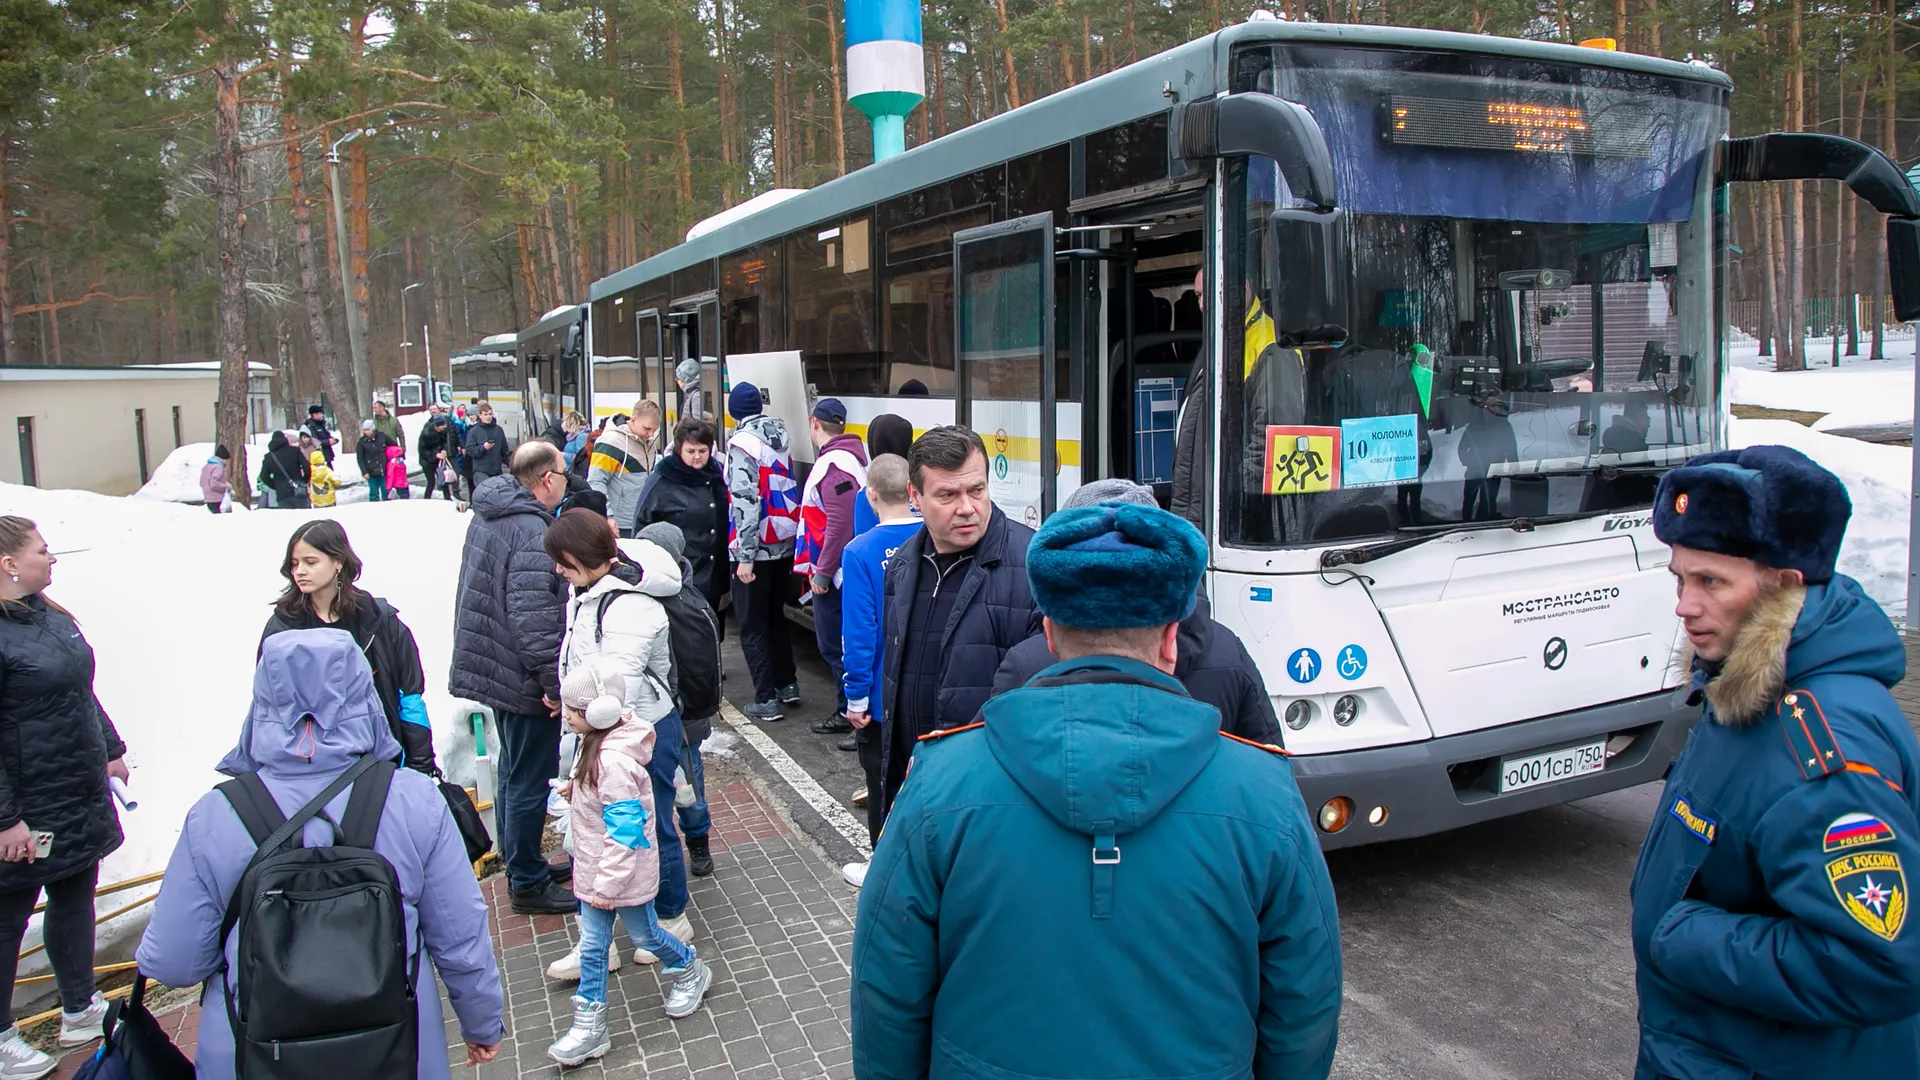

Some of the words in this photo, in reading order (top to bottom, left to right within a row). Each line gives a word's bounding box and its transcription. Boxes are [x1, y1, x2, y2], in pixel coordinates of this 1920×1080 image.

[1372, 429, 1413, 440] КОЛОМНА
[1347, 440, 1368, 460] 10
[1503, 587, 1620, 616] МОСТРАНСАВТО
[1513, 614, 1547, 624] РЕГУЛЯРНЫЕ
[1547, 610, 1575, 619] МАРШРУТЫ
[1576, 604, 1611, 614] ПОДМОСКОВЬЯ
[1577, 746, 1601, 766] 750
[1840, 832, 1877, 846] РОССИЯ
[1831, 859, 1853, 876] МЧС
[1853, 854, 1896, 868] РОССИИ
